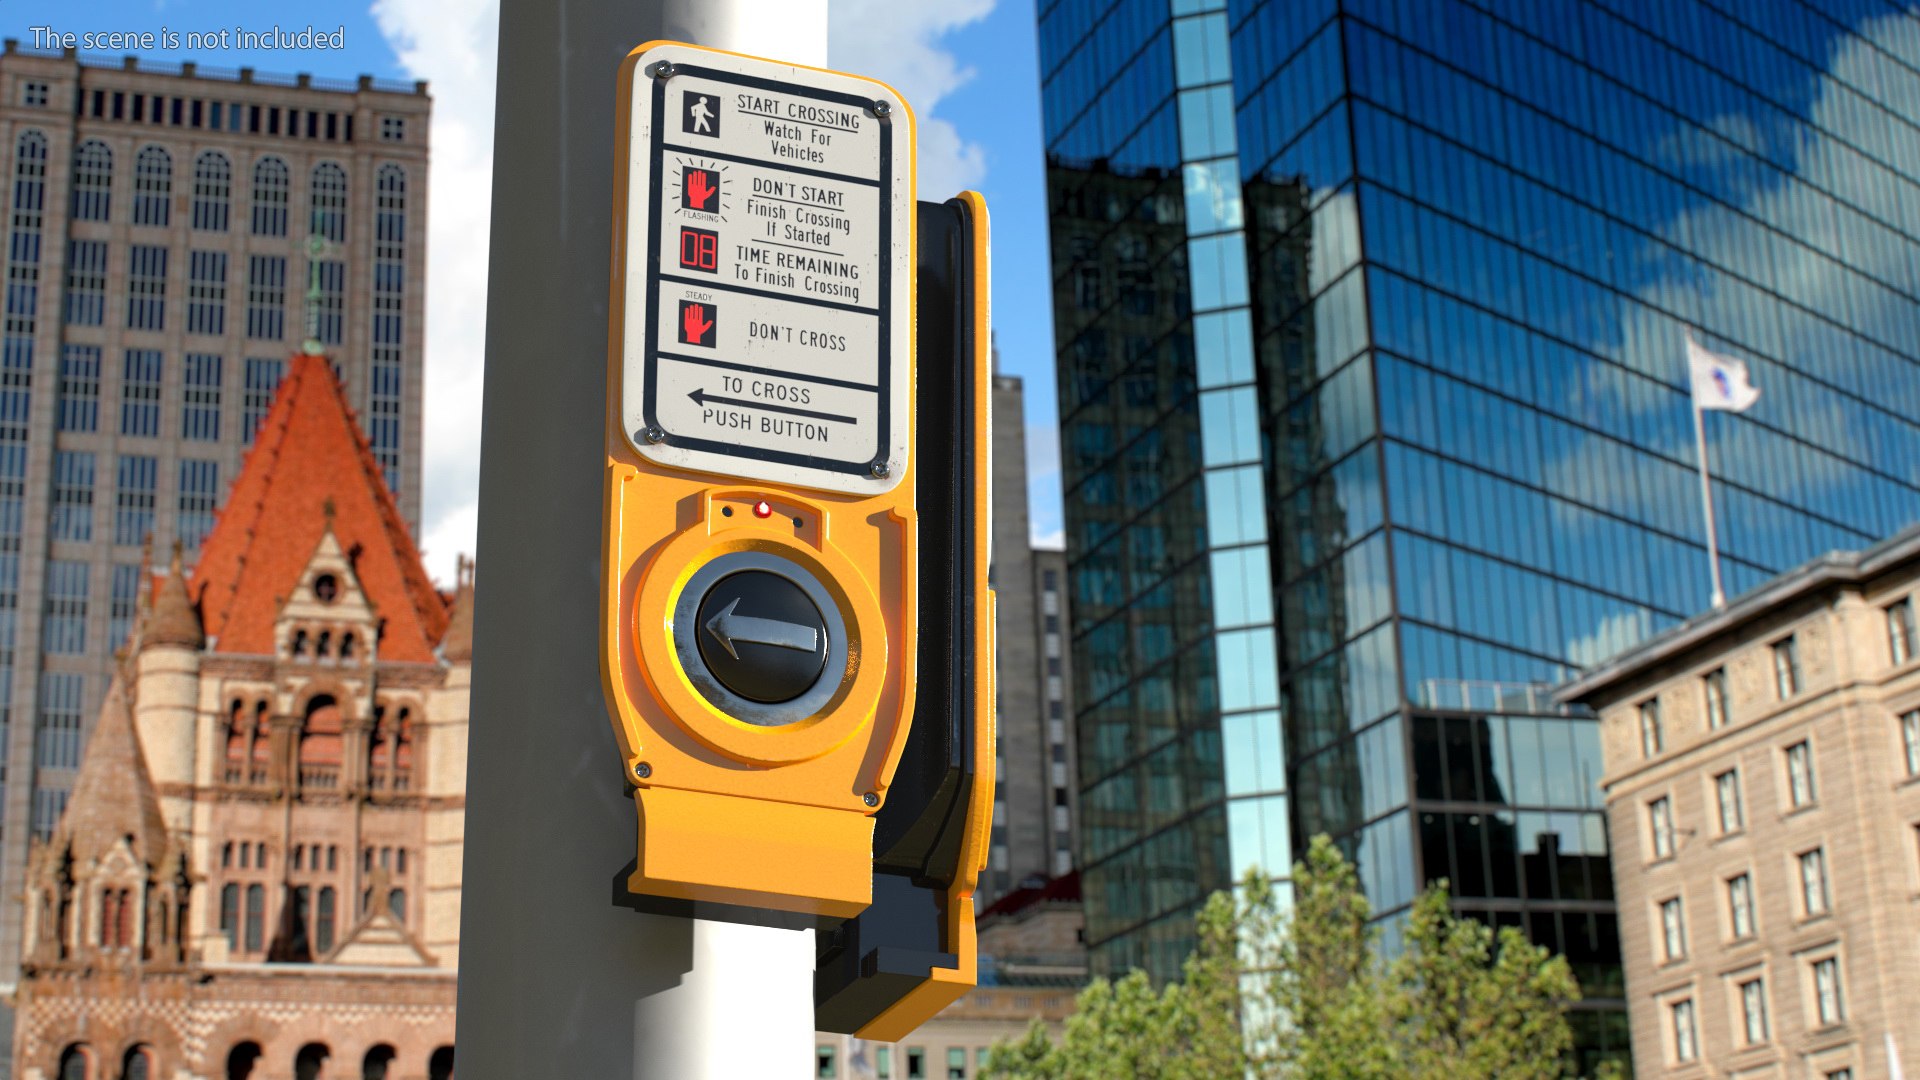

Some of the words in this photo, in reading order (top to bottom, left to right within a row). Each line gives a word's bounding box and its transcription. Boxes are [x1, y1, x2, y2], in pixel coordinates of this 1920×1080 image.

[737, 94, 780, 115] START
[788, 103, 860, 129] CROSSING
[764, 120, 801, 142] Watch
[811, 128, 832, 146] For
[771, 140, 825, 163] Vehicles
[753, 177, 796, 198] DON'T
[801, 186, 844, 206] START
[683, 210, 719, 223] FLASHING
[747, 199, 786, 220] Finish
[796, 207, 850, 236] Crossing
[767, 221, 776, 237] If
[784, 224, 830, 246] Started
[681, 231, 717, 269] 08
[736, 245, 771, 265] TIME
[777, 252, 859, 280] REMAINING
[685, 290, 713, 302] STEADY
[734, 263, 749, 280] To
[755, 267, 795, 288] Finish
[804, 276, 859, 304] Crossing
[749, 321, 793, 343] DON'T
[800, 332, 847, 352] CROSS
[722, 375, 743, 394] TO
[752, 381, 811, 405] CROSS
[702, 408, 752, 430] PUSH
[761, 417, 829, 443] BUTTON
